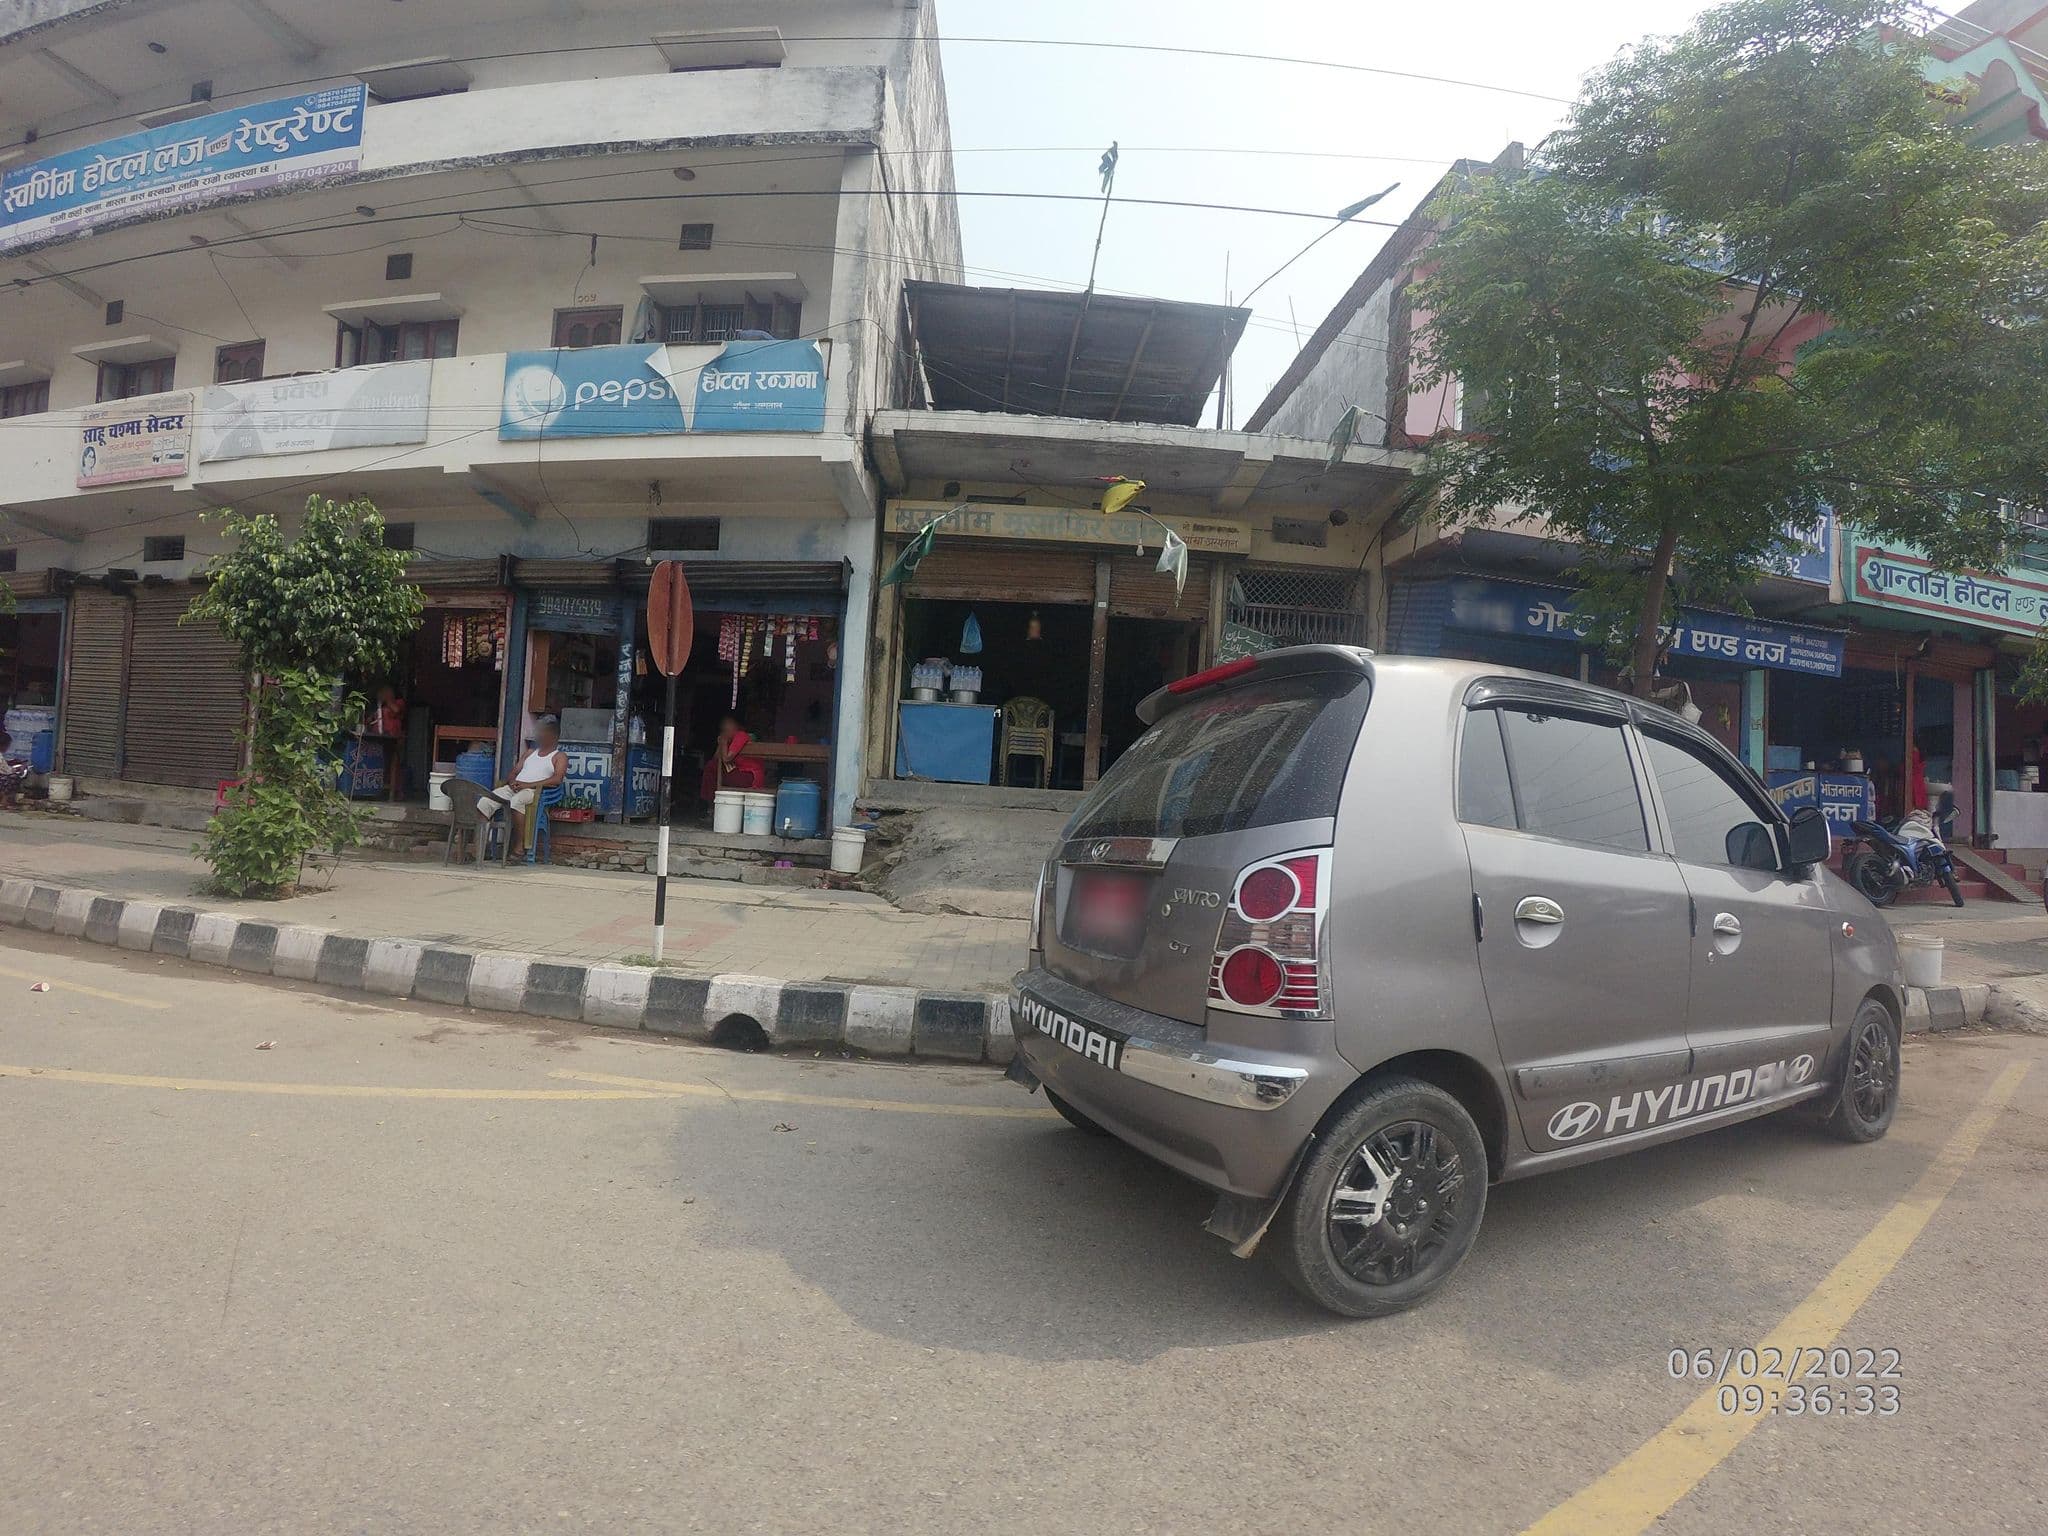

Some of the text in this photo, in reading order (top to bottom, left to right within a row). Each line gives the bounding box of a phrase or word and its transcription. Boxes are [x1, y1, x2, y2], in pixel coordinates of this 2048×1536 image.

[152, 135, 206, 174] लज
[177, 178, 199, 191] लागि
[278, 161, 353, 182] 9847047204
[702, 368, 751, 392] होटल
[83, 415, 186, 446] साहू चश्मा सेन्टर
[1954, 575, 2011, 612] होटल
[1691, 629, 1740, 656] एण्ड
[1745, 638, 1787, 663] लज
[1822, 802, 1860, 822] लज
[1170, 888, 1220, 908] SANTRO
[1021, 999, 1117, 1070] HYUNDAI
